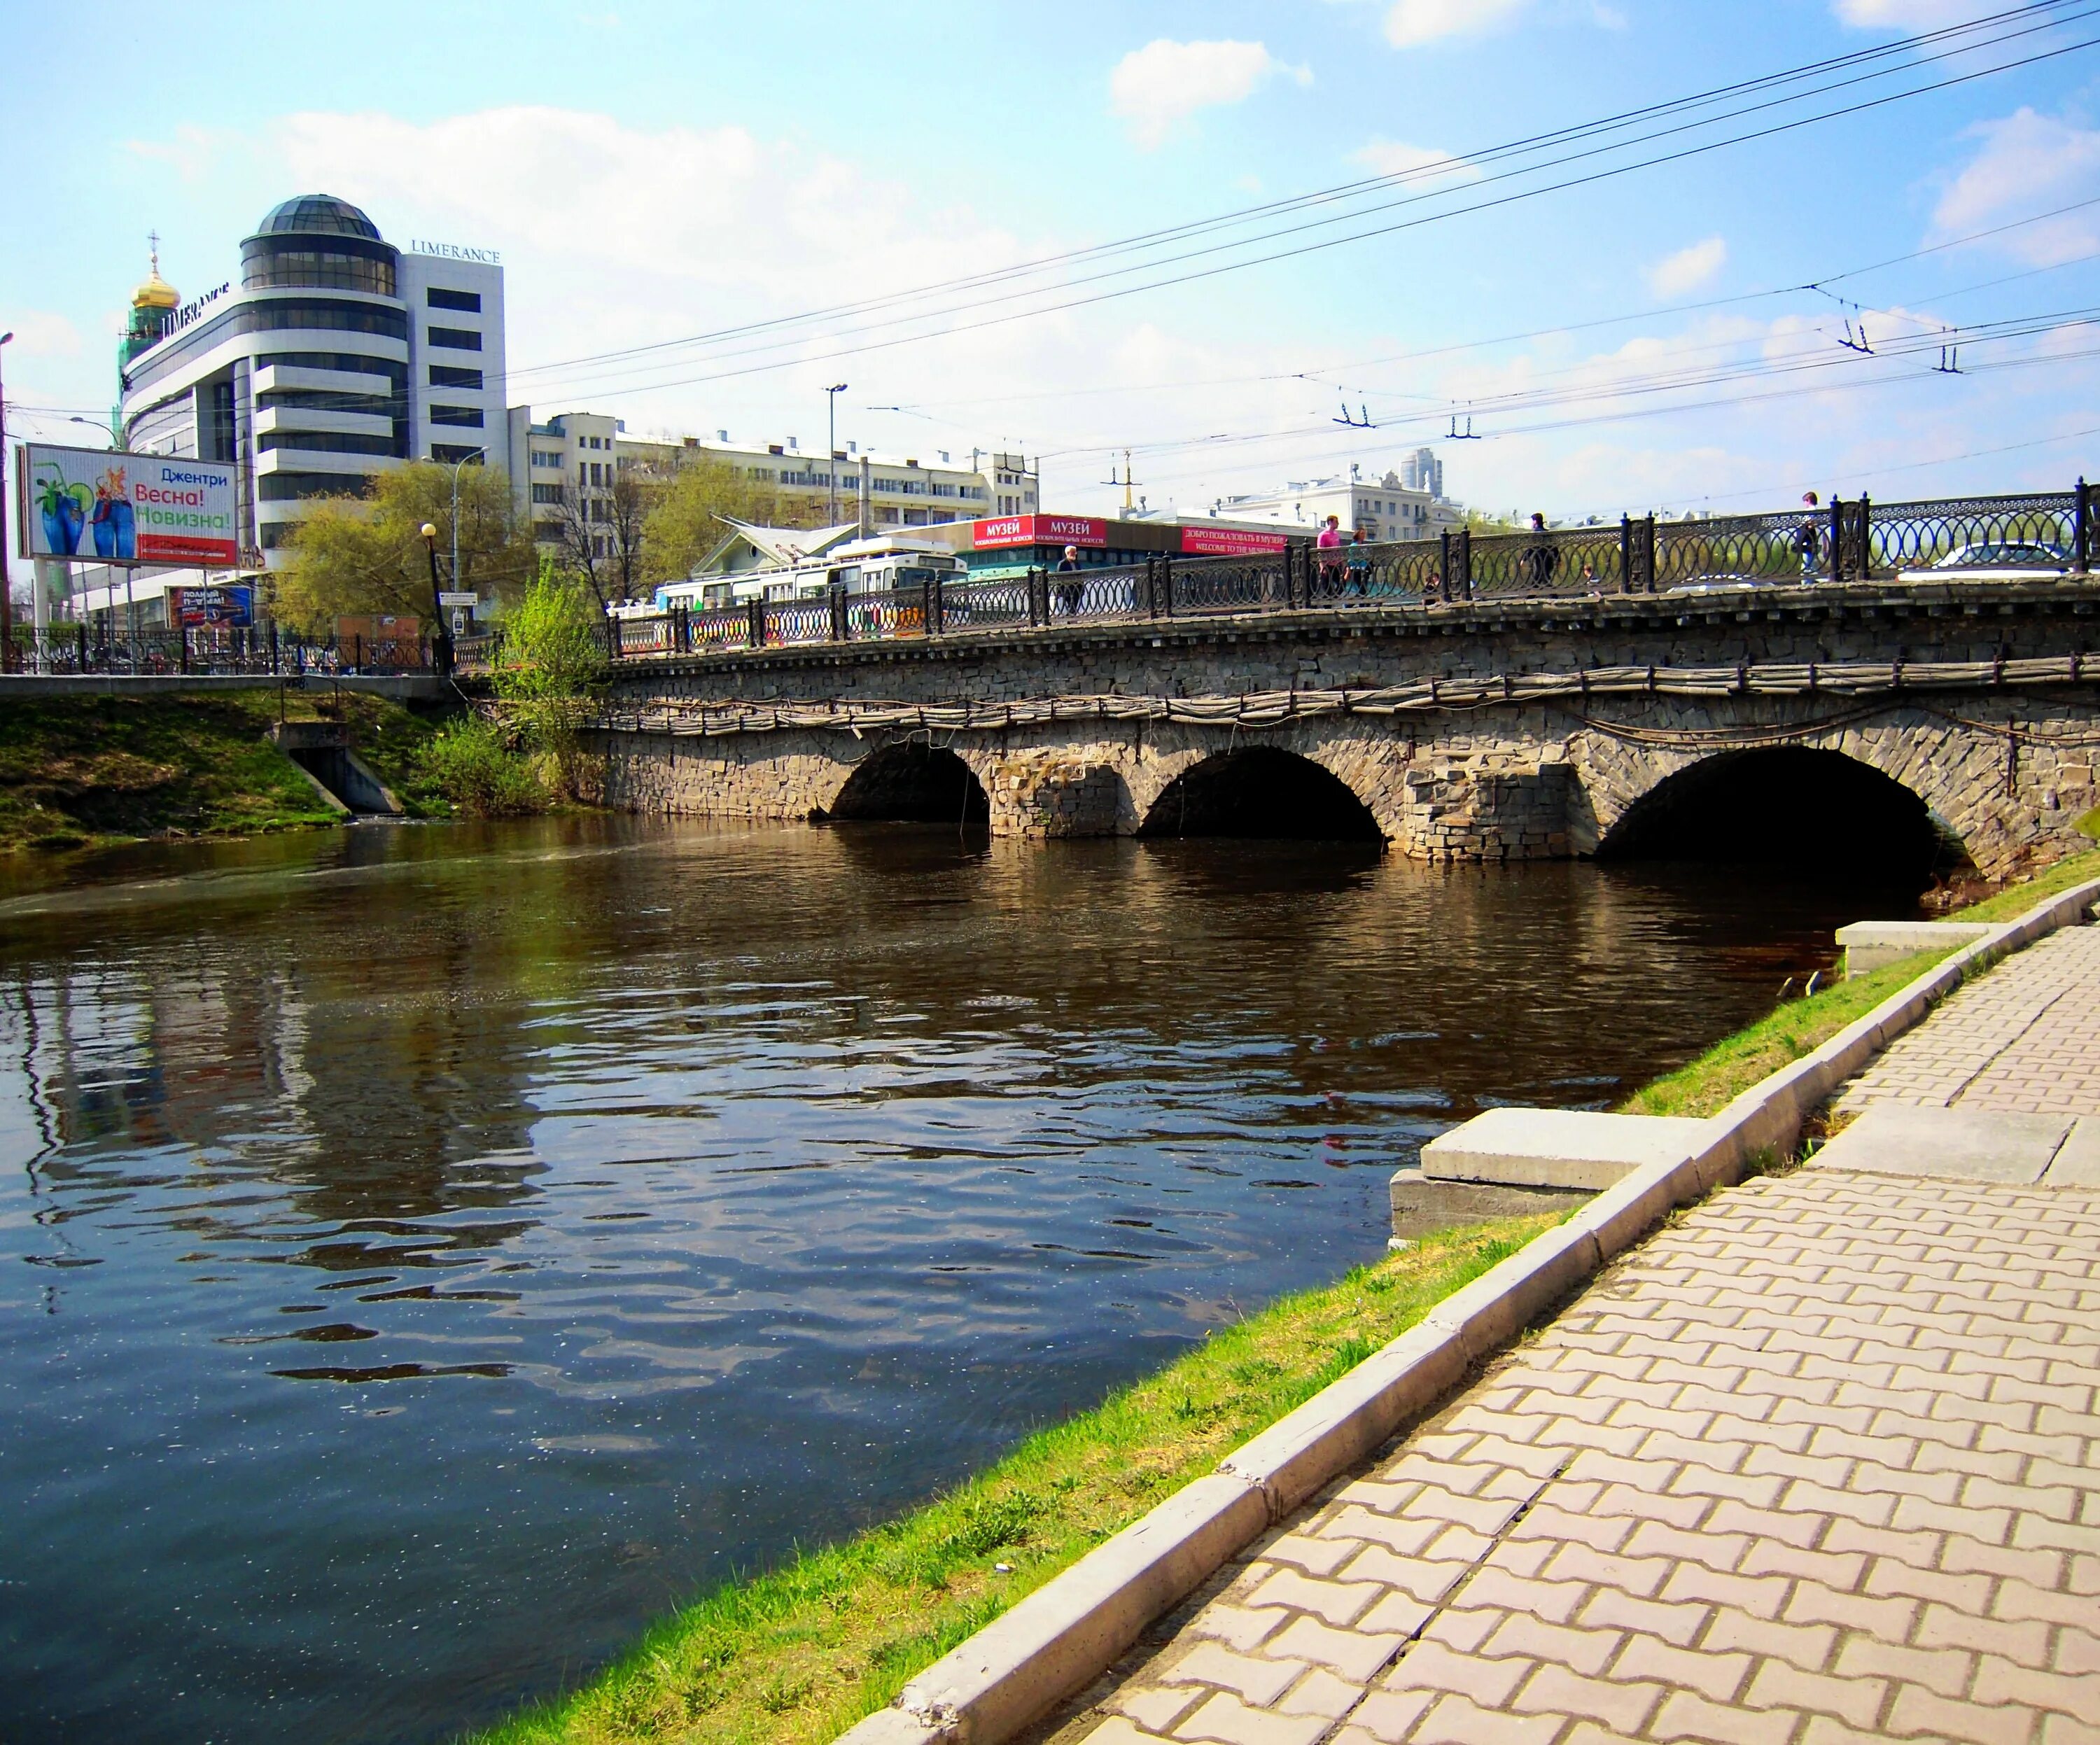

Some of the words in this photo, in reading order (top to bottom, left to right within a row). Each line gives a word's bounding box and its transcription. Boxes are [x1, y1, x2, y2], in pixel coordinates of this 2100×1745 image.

[412, 239, 500, 263] LIMERANCE
[162, 468, 227, 488] Джентри
[135, 484, 204, 507] Весна!
[136, 505, 230, 530] Новизна!
[986, 519, 1020, 537] МУЗЕЙ
[1051, 520, 1090, 535] МУЗЕЙ
[1185, 528, 1208, 538] ДОБРО
[1210, 531, 1255, 542] ПОЖАЛОВАТЬ
[1196, 542, 1226, 551] WELCOME
[1227, 545, 1236, 553] TO
